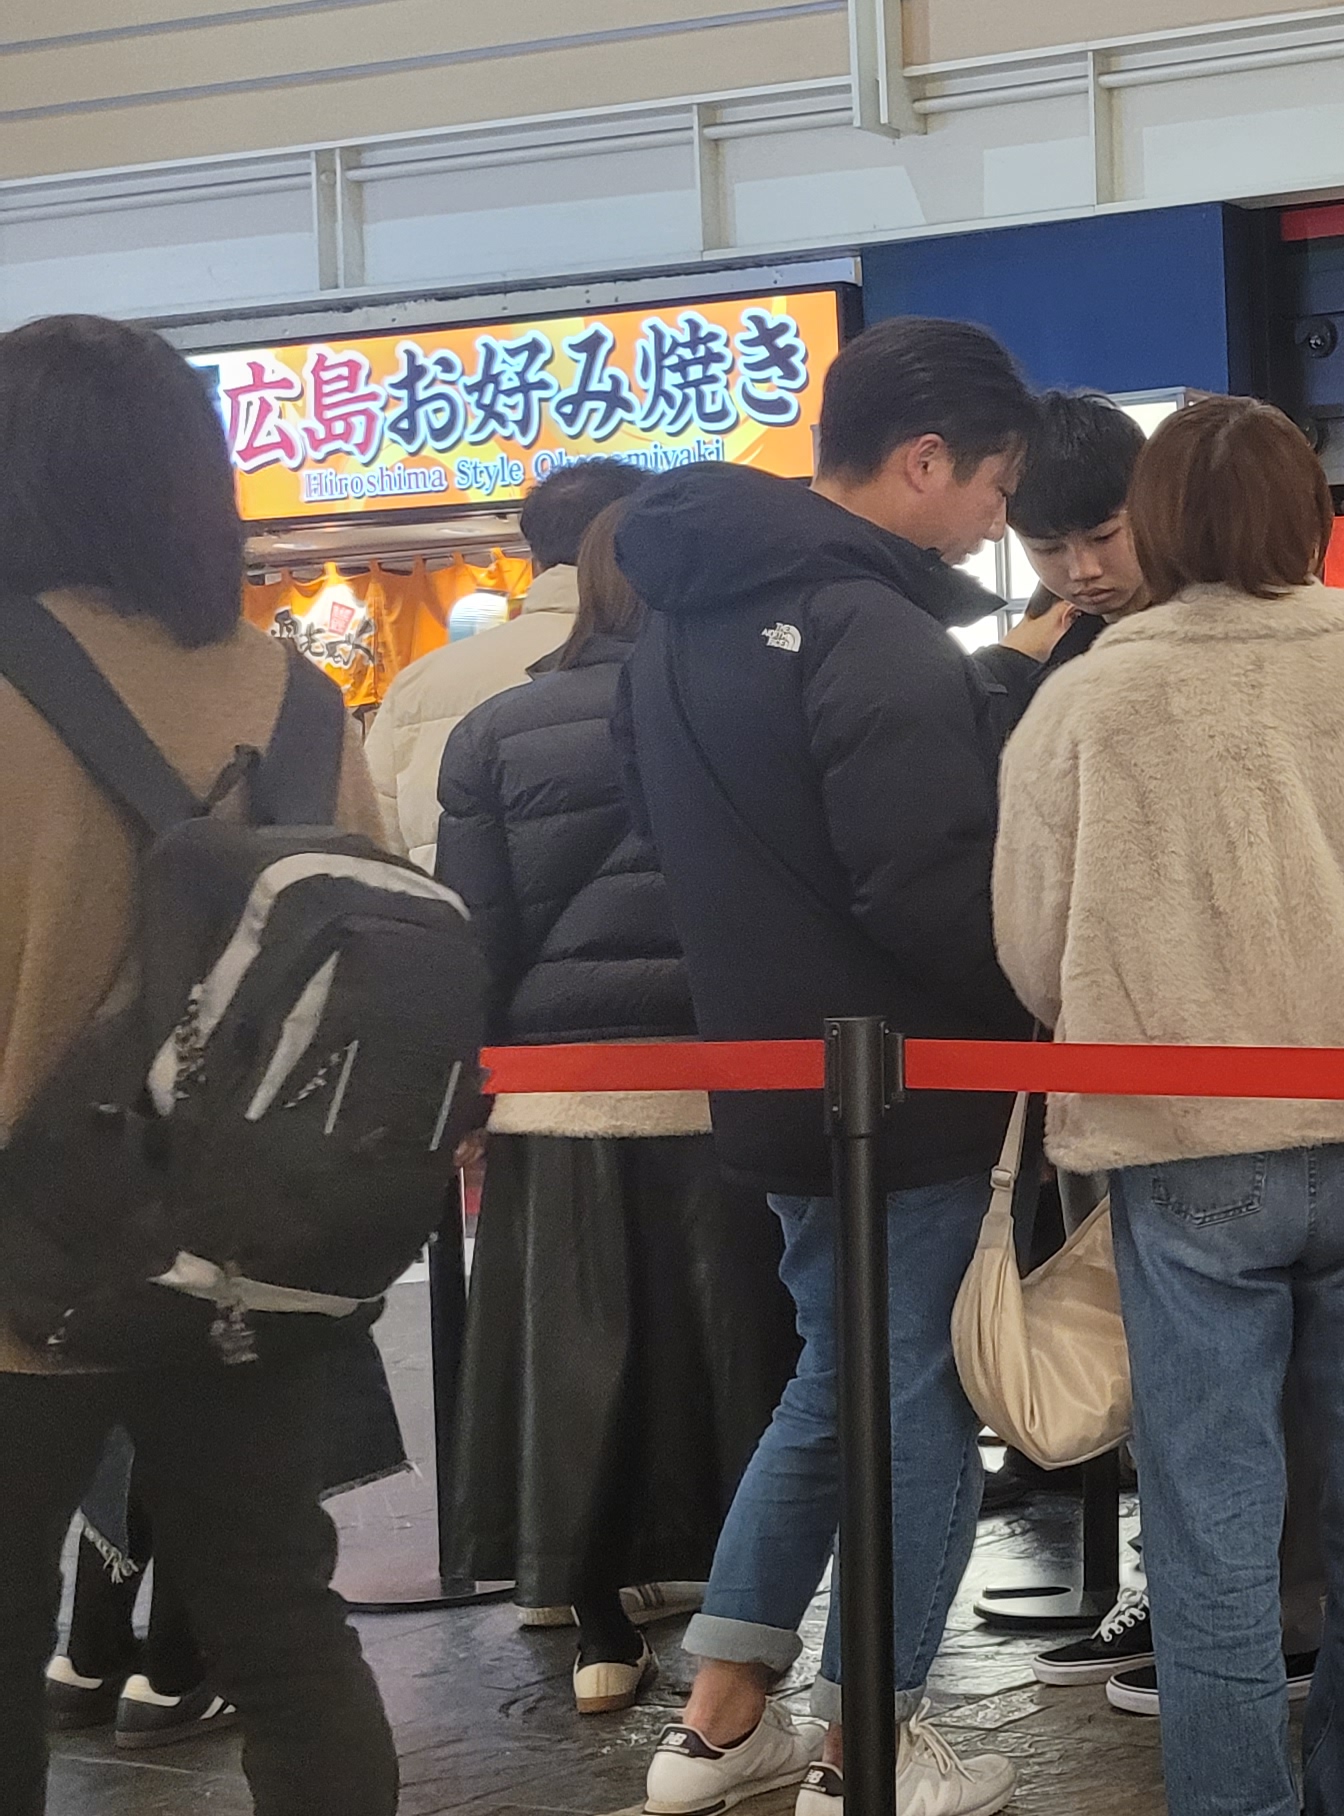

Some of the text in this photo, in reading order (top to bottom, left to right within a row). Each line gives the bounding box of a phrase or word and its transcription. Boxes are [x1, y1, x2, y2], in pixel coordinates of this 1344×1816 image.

[225, 309, 809, 472] 広島お好み焼き
[304, 463, 445, 503] Hiroshima
[456, 456, 523, 490] Style
